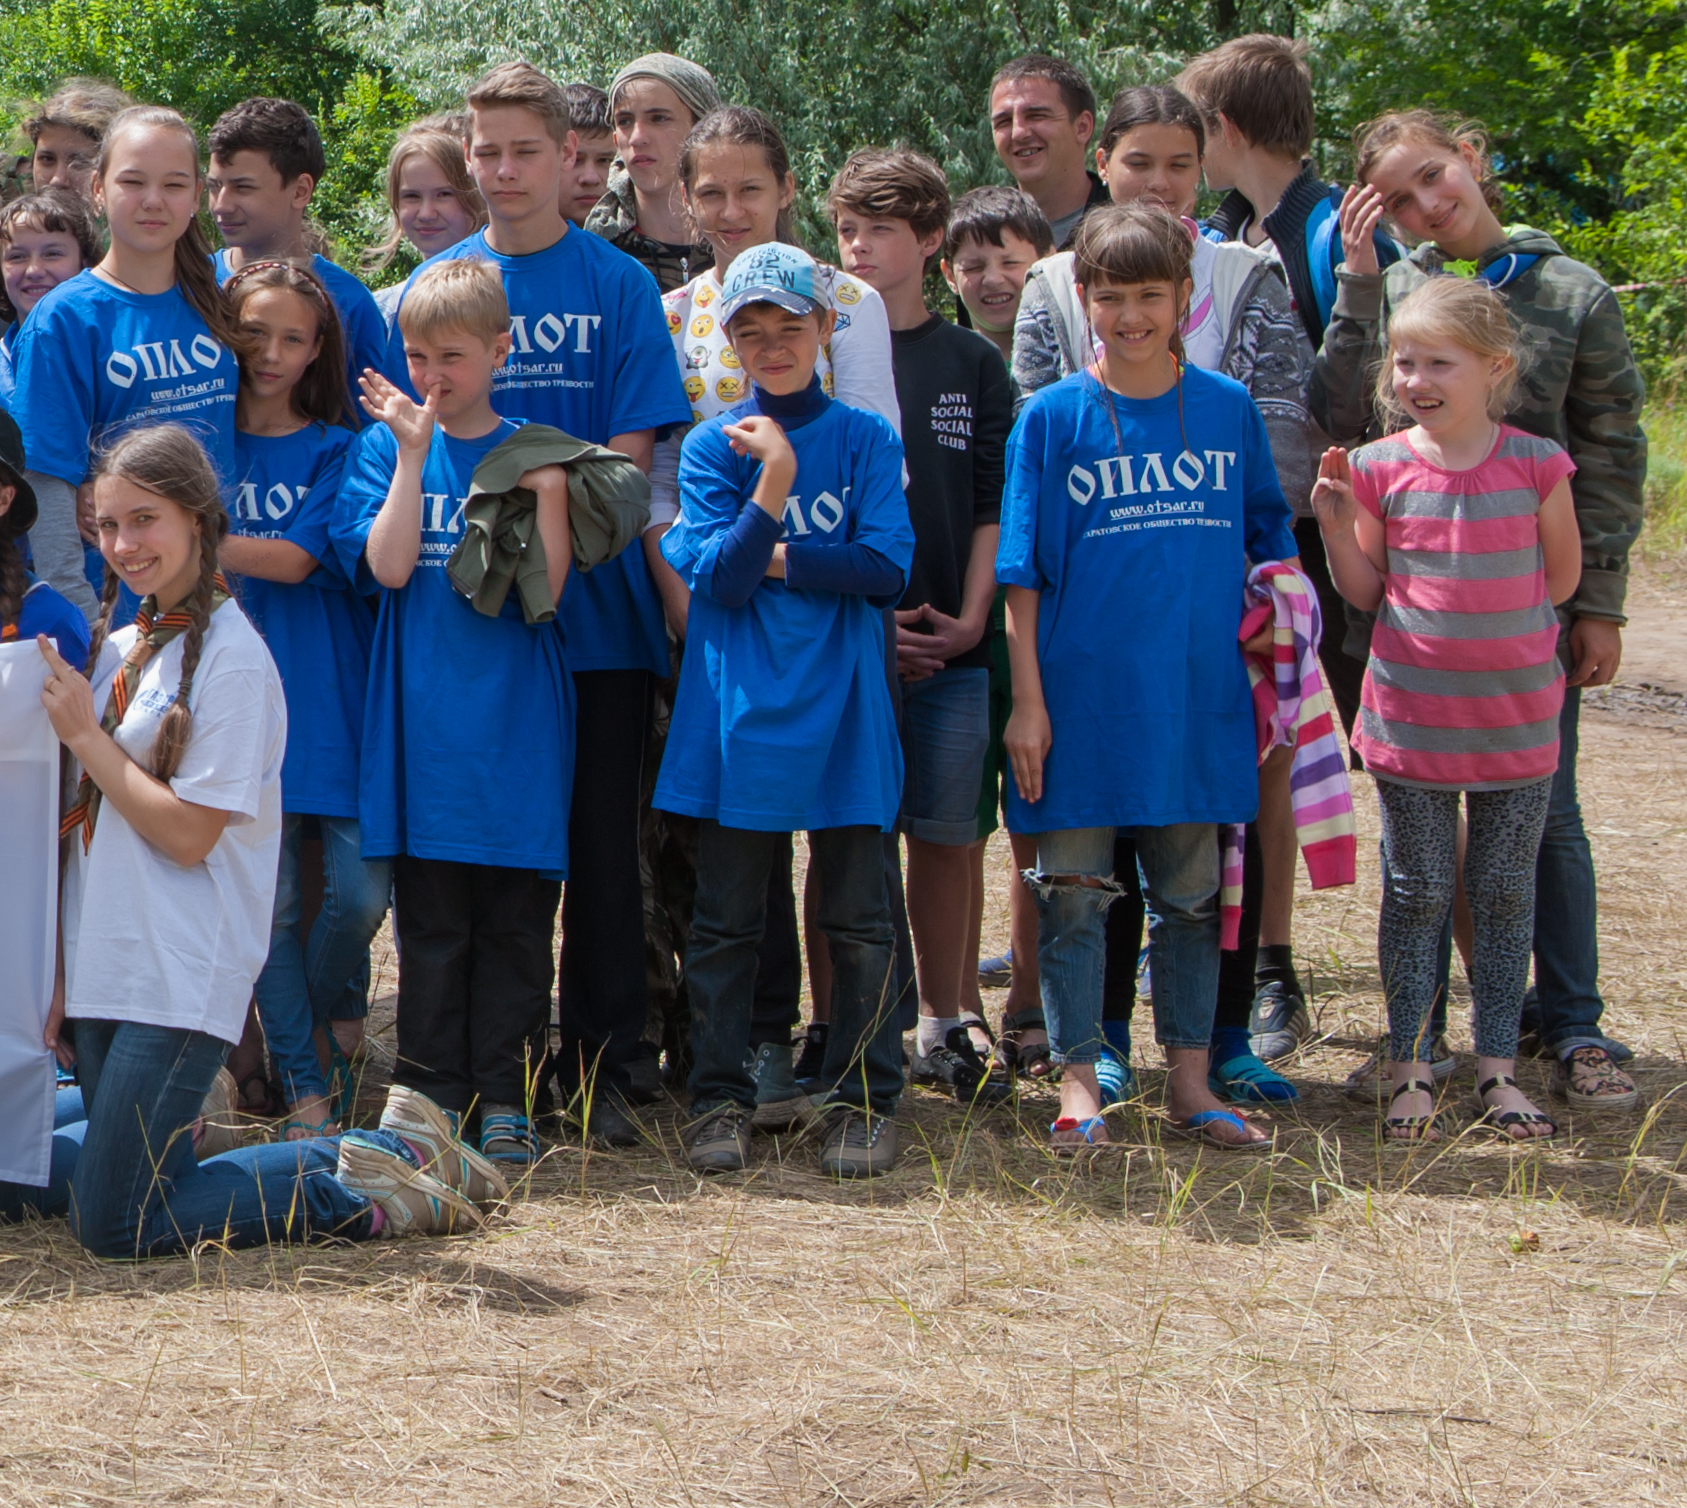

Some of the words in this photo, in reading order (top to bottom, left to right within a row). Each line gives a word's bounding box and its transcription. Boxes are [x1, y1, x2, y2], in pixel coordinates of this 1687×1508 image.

[732, 269, 795, 293] CREW
[509, 313, 602, 353] ЛОТ
[106, 333, 227, 389] ОПЛО
[151, 378, 225, 401] www.otsar.ru
[939, 393, 967, 404] ANTI
[931, 406, 973, 418] SOCIAL
[931, 420, 972, 436] SOCIAL
[938, 434, 966, 450] CLUB
[1067, 449, 1236, 506] ОПЛОТ
[1110, 500, 1204, 520] www.otsar.ru
[1143, 517, 1195, 529] ОБЩЕСТВО
